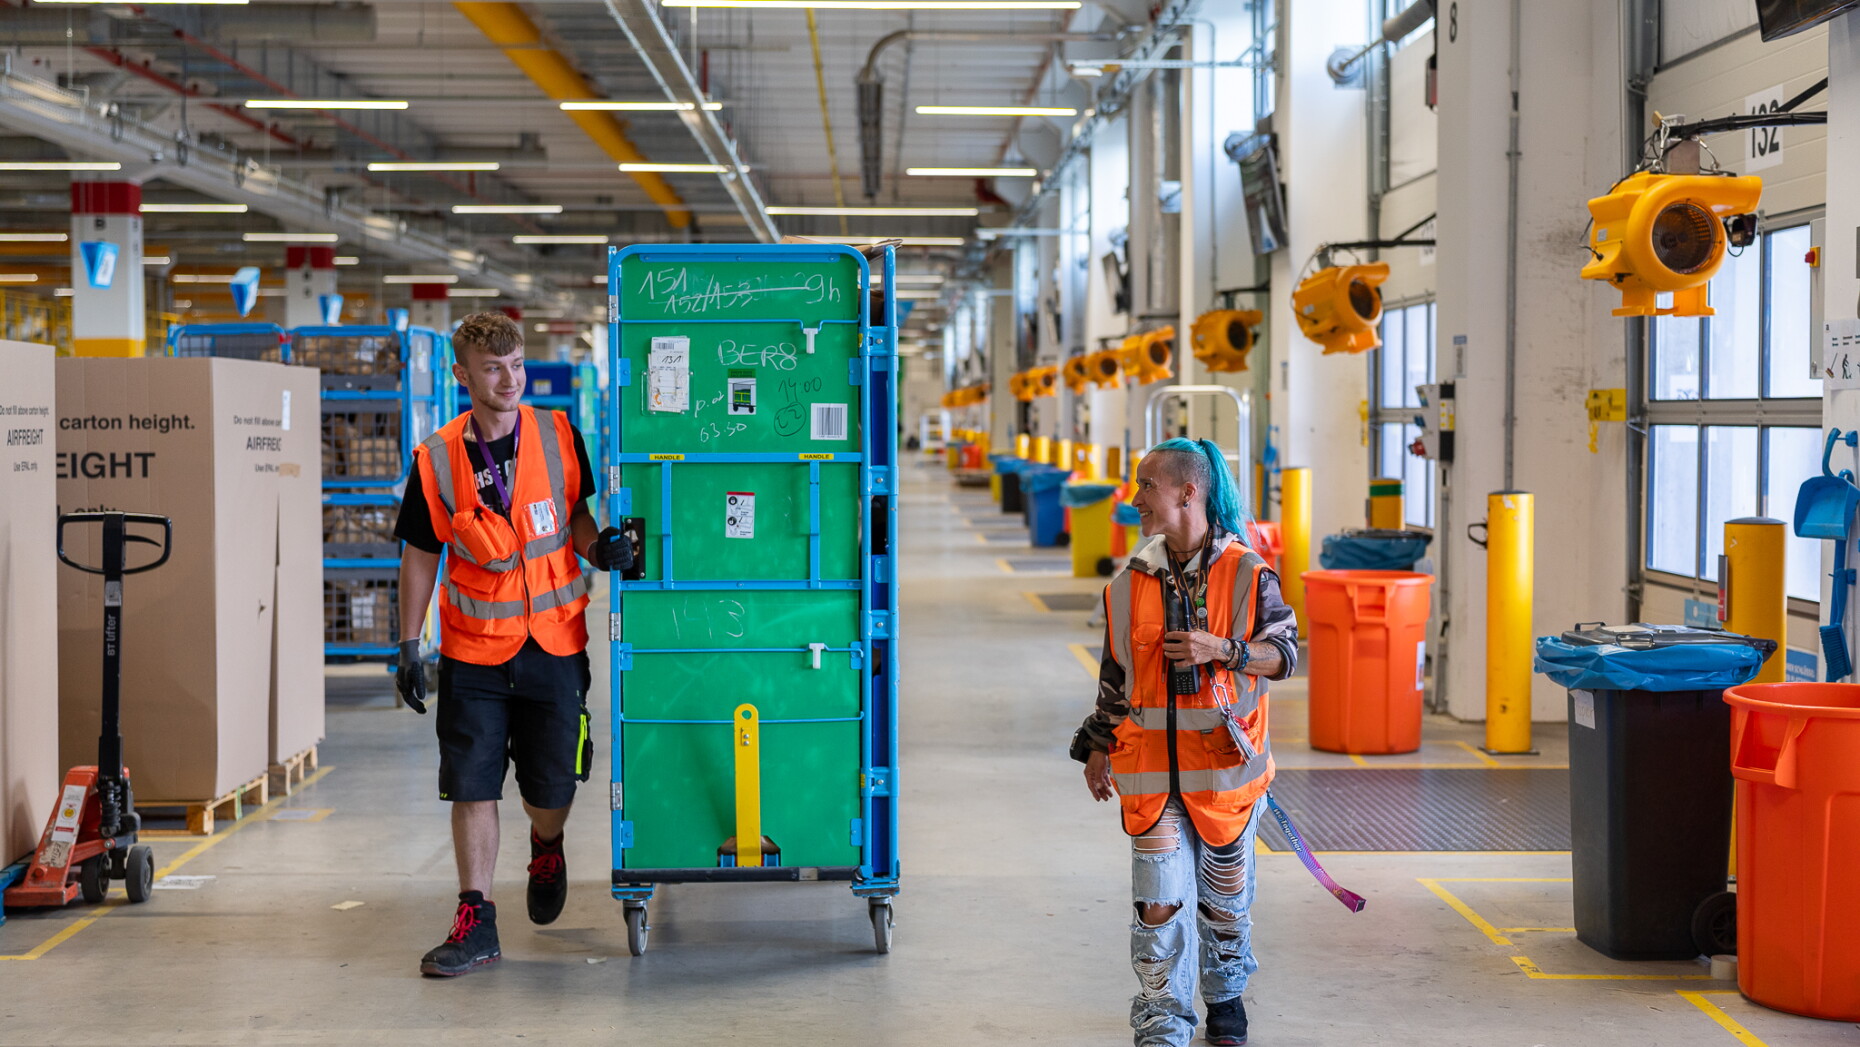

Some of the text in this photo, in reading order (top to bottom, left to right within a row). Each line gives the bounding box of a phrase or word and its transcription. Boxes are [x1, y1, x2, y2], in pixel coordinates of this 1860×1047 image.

[1449, 1, 1458, 44] 8
[1751, 99, 1780, 158] 132
[717, 339, 798, 371] BER8
[7, 428, 44, 447] AIRFREIGHT
[59, 414, 196, 434] carton height.
[107, 643, 116, 657] BT
[1280, 819, 1303, 853] Together
